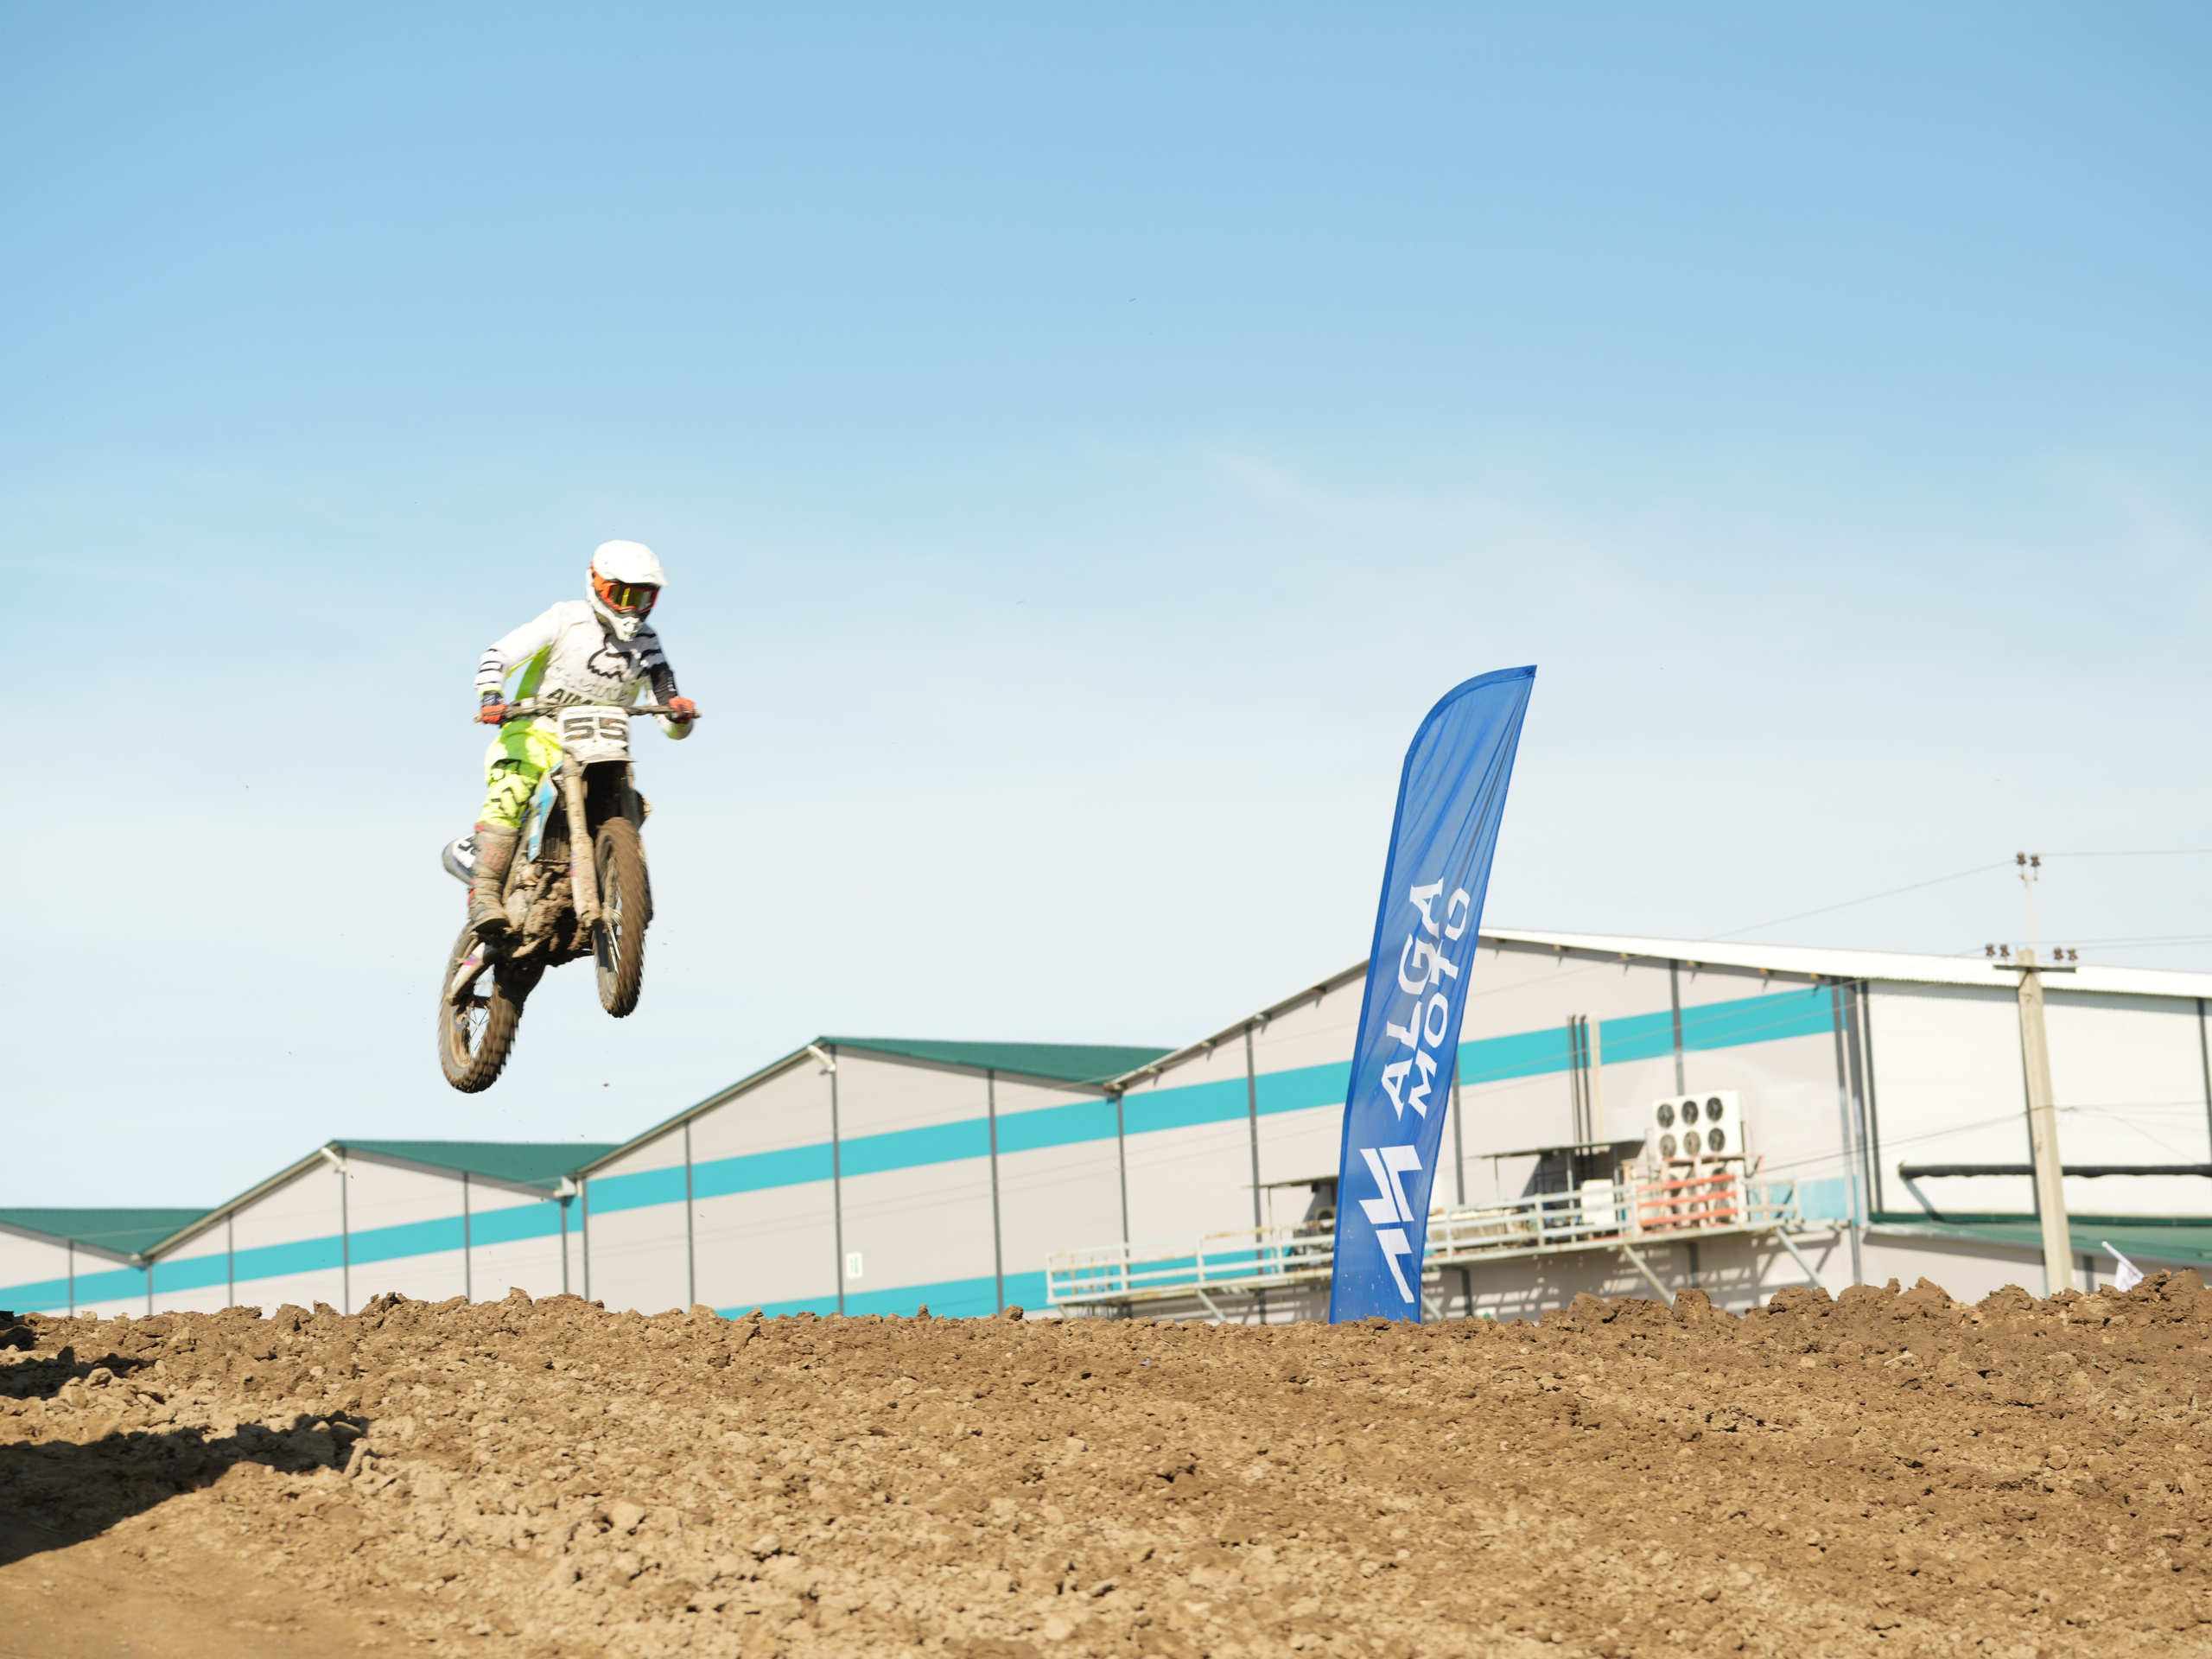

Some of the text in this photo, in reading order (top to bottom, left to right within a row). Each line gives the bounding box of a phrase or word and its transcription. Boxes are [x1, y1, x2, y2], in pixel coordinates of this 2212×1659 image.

[563, 716, 628, 741] 55
[1381, 876, 1444, 1122] ALGA
[1408, 887, 1471, 1120] MOTO
